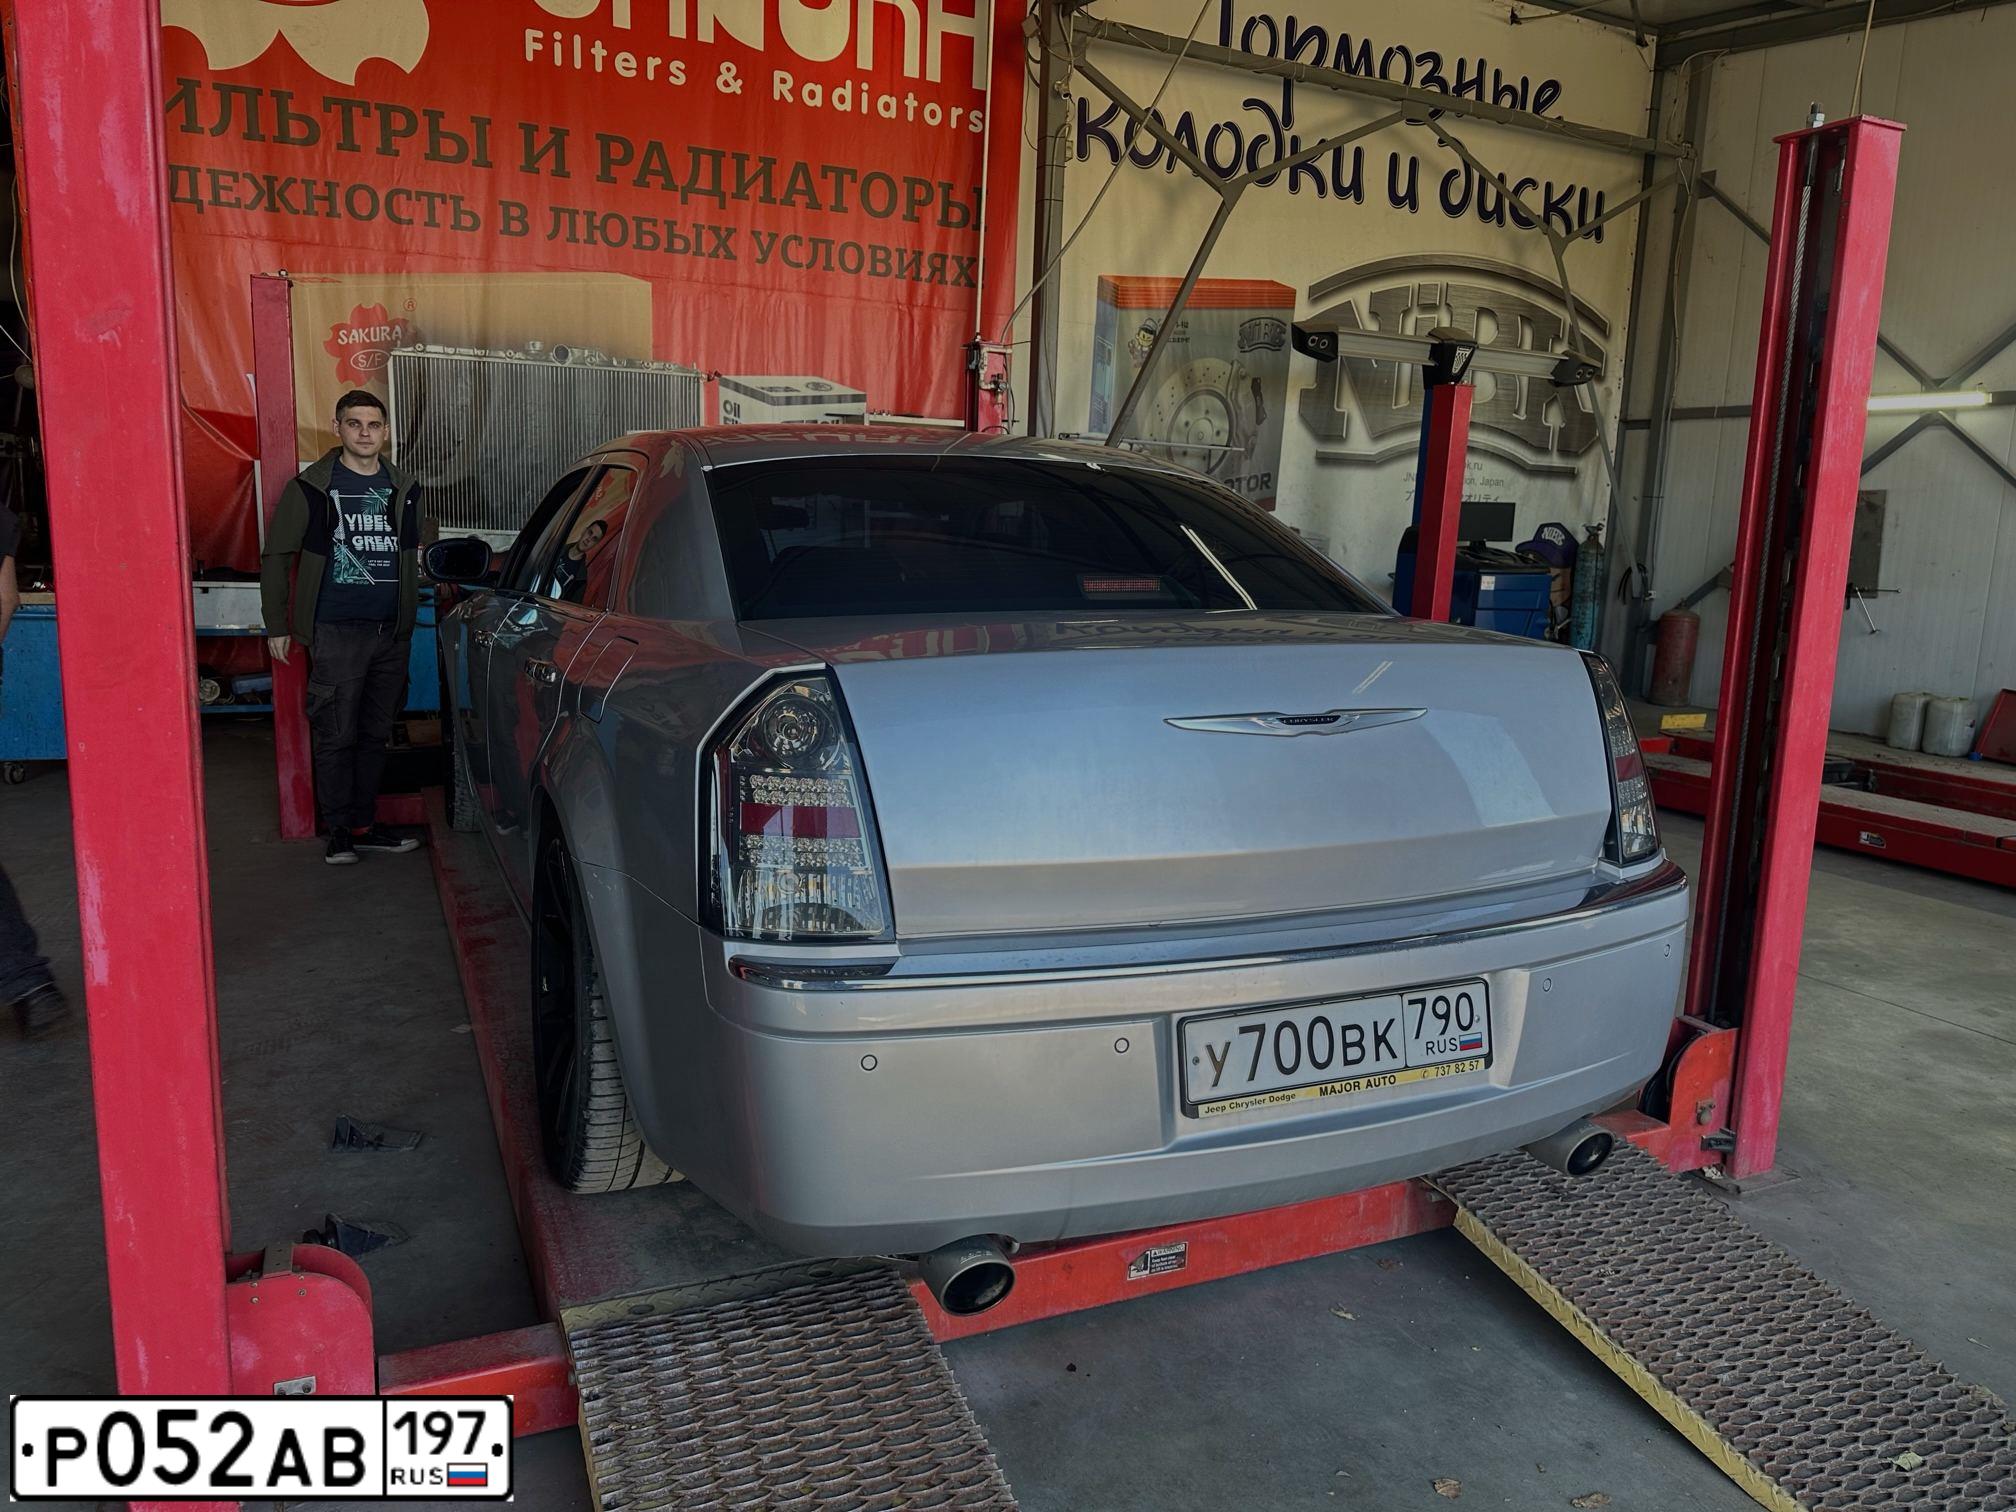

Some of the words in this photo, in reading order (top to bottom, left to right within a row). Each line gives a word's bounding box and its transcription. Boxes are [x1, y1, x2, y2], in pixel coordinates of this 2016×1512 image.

[525, 28, 687, 86] Filters
[716, 62, 743, 95] &
[773, 70, 984, 133] Radiators
[518, 123, 571, 178] И
[595, 132, 987, 232] РАДИАТОРЫ
[1077, 96, 1365, 204] колодки
[1387, 152, 1419, 213] и
[1440, 138, 1605, 243] диски
[499, 200, 530, 236] В
[546, 206, 738, 261] ЛЮБЫХ
[338, 325, 402, 345] SAKURA
[357, 353, 383, 368] S/F
[723, 400, 740, 418] Oil
[1479, 477, 1505, 487] Japan
[344, 513, 393, 532] VIBES
[1206, 1016, 1398, 1087] У700ВК
[1407, 992, 1475, 1040] 790
[1425, 1037, 1458, 1056] RUS
[1204, 1104, 1227, 1115] Jeep
[1229, 1096, 1267, 1111] Chrysler
[1268, 1091, 1297, 1105] Dodge
[1319, 1082, 1361, 1097] MAJOR
[1365, 1074, 1397, 1088] AUTO
[1435, 1065, 1451, 1078] 737
[1454, 1062, 1467, 1074] 82
[1468, 1060, 1480, 1072] 57
